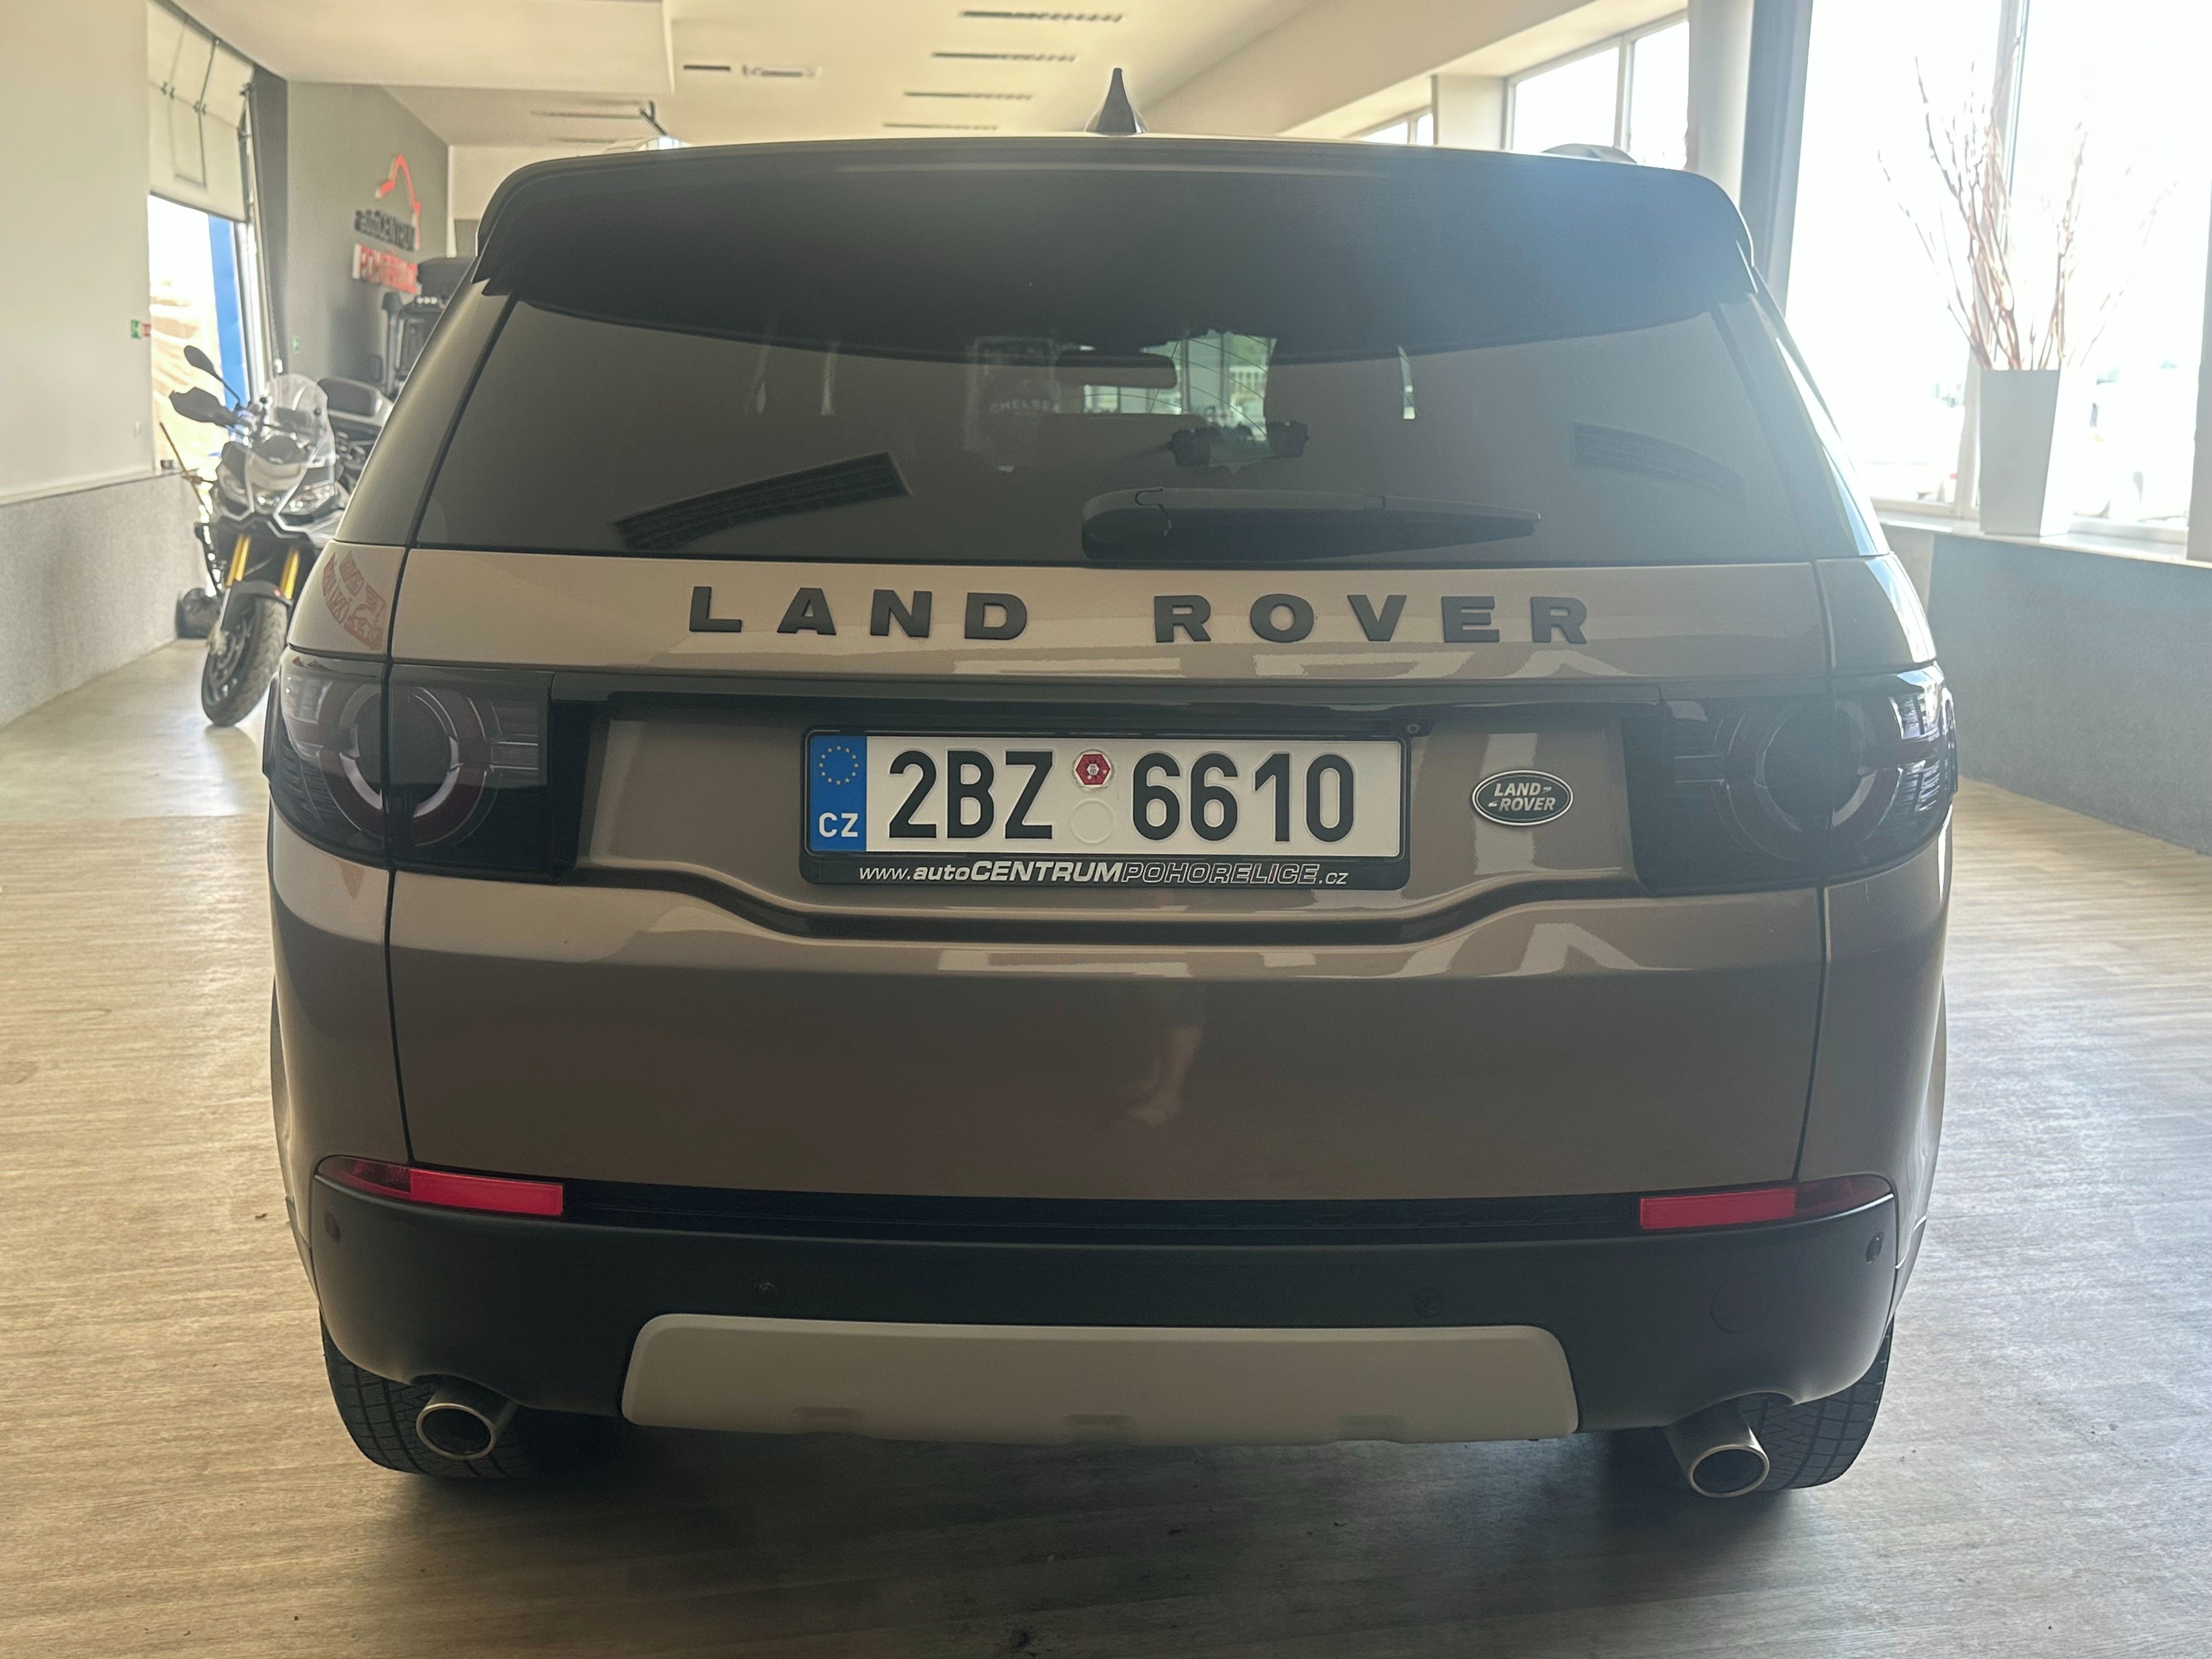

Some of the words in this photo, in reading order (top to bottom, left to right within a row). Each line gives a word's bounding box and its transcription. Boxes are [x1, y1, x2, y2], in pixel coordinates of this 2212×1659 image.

[689, 586, 1027, 640] LAND
[1154, 594, 1587, 644] ROVER
[888, 750, 1053, 839] 2BZ
[1132, 752, 1355, 842] 6610
[1494, 783, 1541, 796] LAND
[1498, 797, 1556, 811] ROVER
[819, 812, 859, 838] CZ
